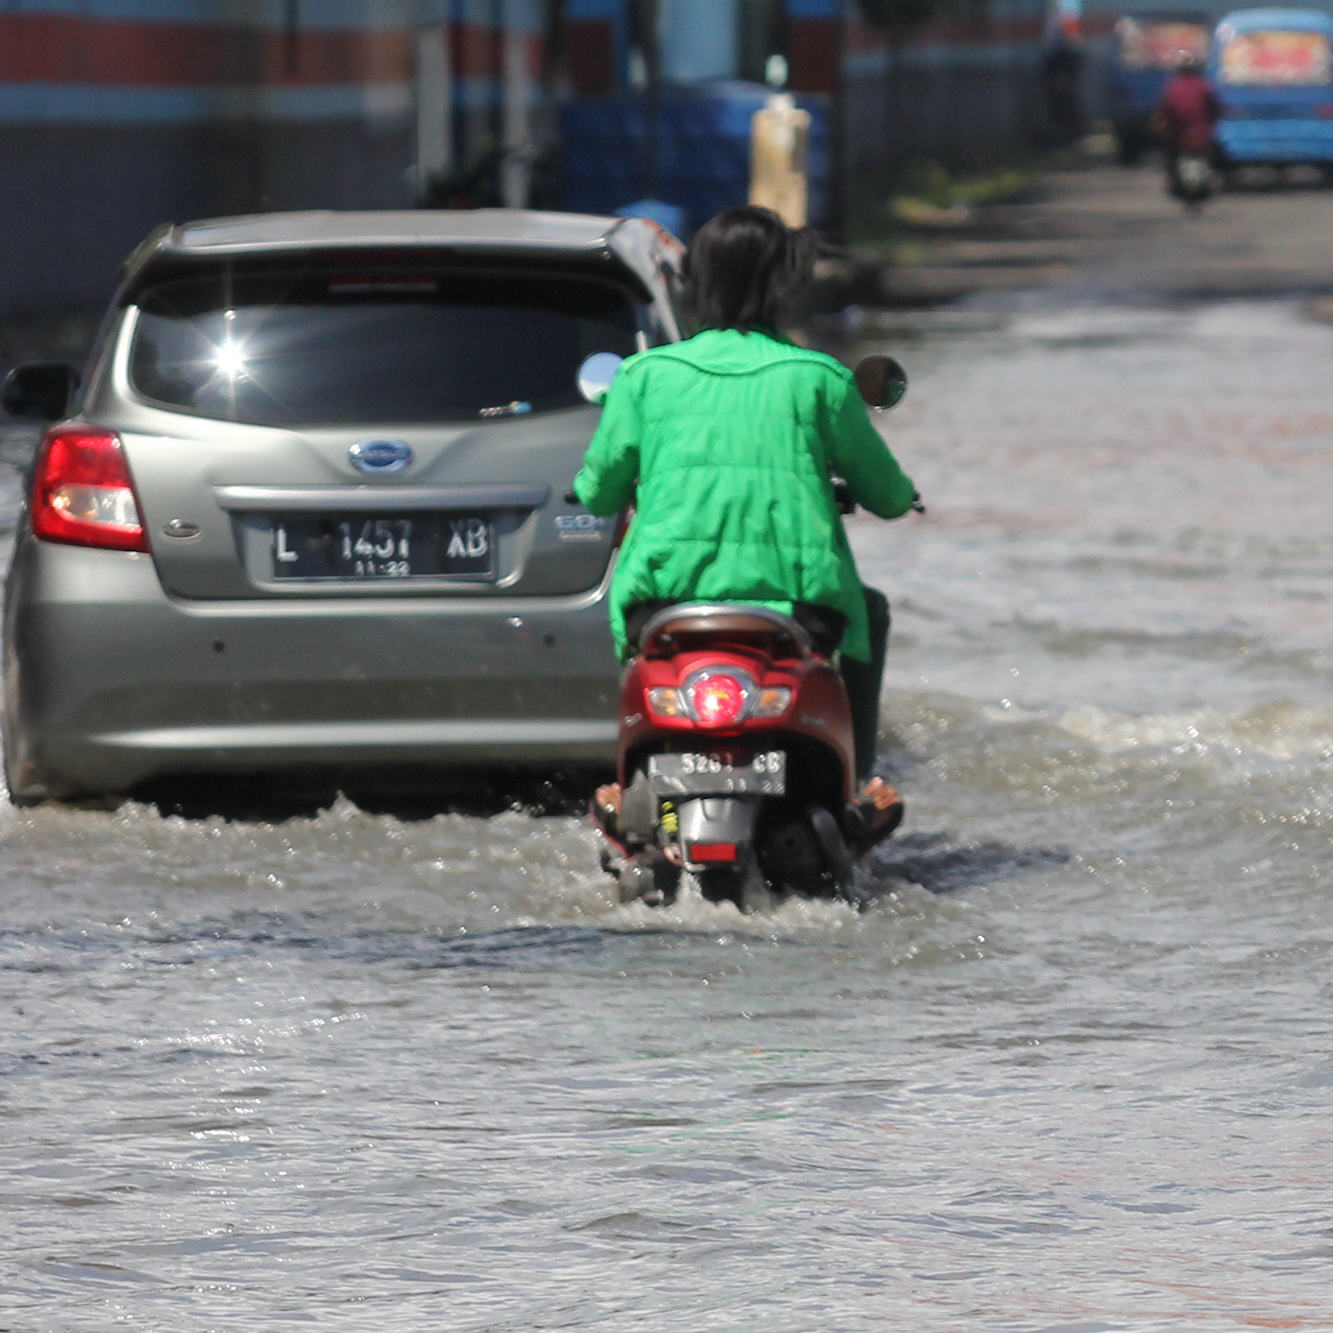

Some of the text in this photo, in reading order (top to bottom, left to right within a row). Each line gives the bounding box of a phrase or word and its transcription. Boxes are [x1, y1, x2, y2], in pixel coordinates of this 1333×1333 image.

[276, 518, 489, 562] L 1457 XB
